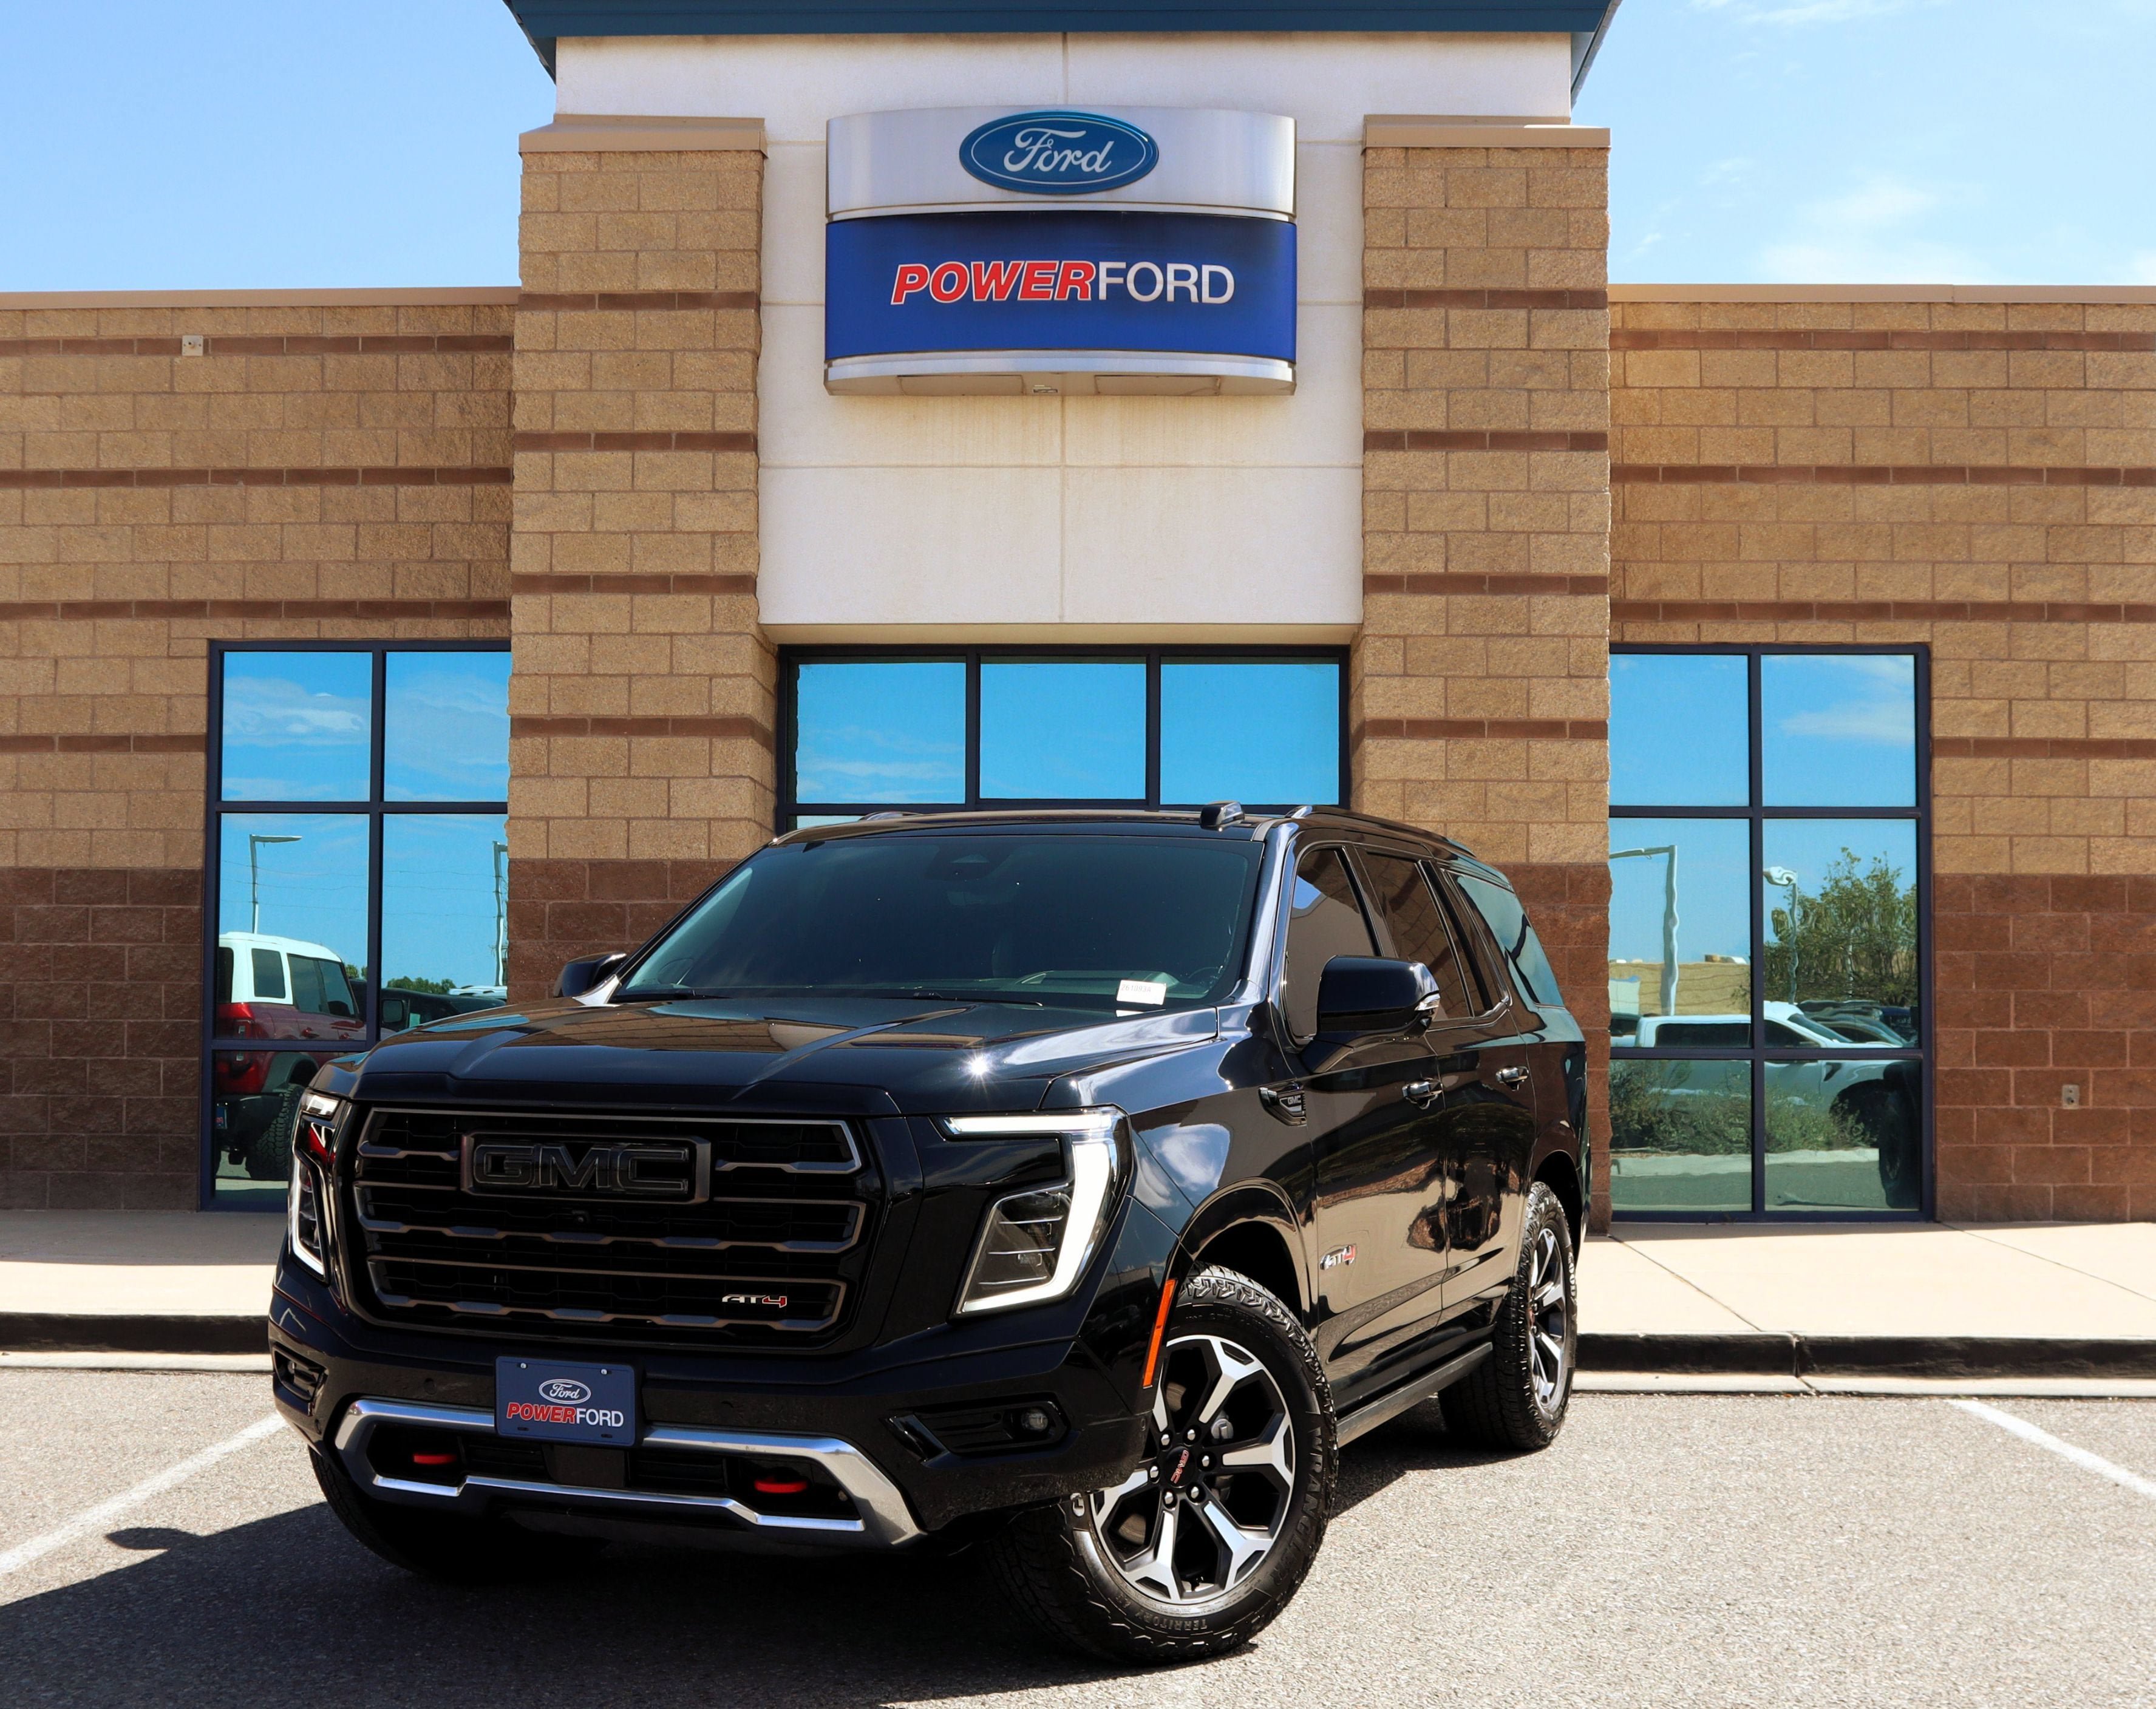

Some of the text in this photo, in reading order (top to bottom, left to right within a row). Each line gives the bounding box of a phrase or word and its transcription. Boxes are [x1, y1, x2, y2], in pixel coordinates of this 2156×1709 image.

[1003, 127, 1114, 174] Ford
[890, 260, 1236, 305] POWERFORD
[1287, 1095, 1302, 1105] GMC
[473, 1143, 689, 1194] GMC
[1320, 1245, 1356, 1270] AT4
[722, 1294, 787, 1308] AT4
[549, 1382, 580, 1399] Ford
[506, 1402, 624, 1427] POWERFORD
[1171, 1450, 1189, 1484] GMC
[1270, 1427, 1323, 1587] WRANGLER
[1135, 1608, 1208, 1631] TERRITORY
